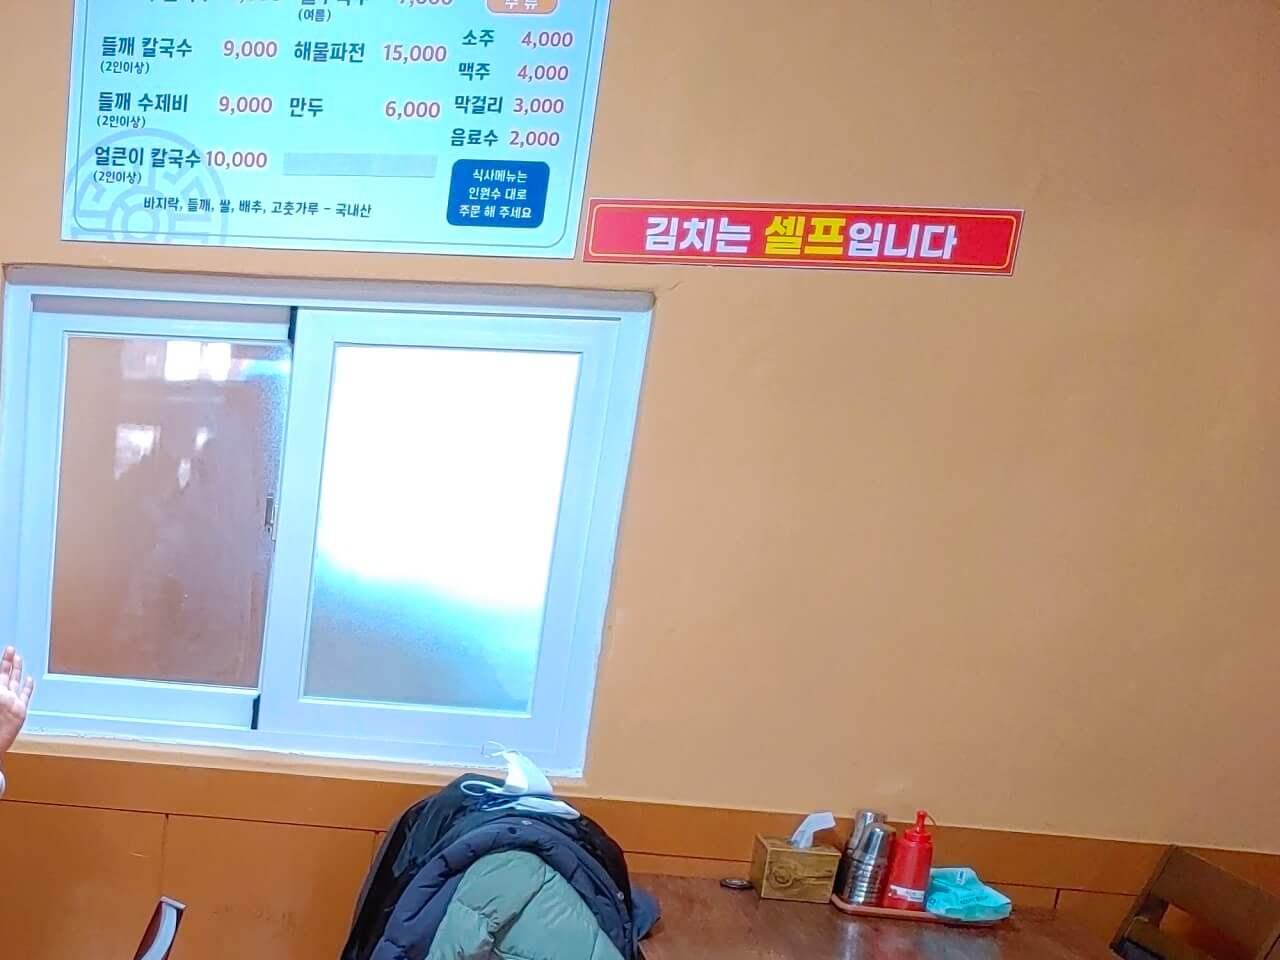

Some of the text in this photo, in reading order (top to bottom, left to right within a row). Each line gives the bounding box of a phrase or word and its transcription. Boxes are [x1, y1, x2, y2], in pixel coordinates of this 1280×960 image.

[298, 8, 331, 22] (여름)
[101, 36, 193, 58] 들깨 칼국수
[462, 30, 495, 48] 소주
[521, 31, 573, 48] 4,000
[223, 39, 278, 59] 9,000
[293, 41, 365, 63] 해물파전
[383, 44, 447, 63] 15,000
[100, 60, 150, 74] (2인이상)
[458, 62, 491, 81] 맥주
[517, 65, 569, 82] 4,000
[98, 92, 188, 112] 들깨 수제비
[218, 96, 273, 115] 9,000
[289, 97, 324, 118] 만두
[385, 101, 441, 119] 6,000
[454, 95, 503, 115] 막걸리
[513, 98, 564, 115] 3,000
[96, 115, 146, 128] (2인이상)
[450, 128, 499, 147] 음료수
[509, 131, 560, 147] 2,000
[95, 146, 201, 168] 얼큰이 칼국수
[206, 150, 268, 169] 10,000
[93, 170, 142, 184] (2인이상)
[472, 168, 528, 183] 식사메뉴는
[469, 186, 527, 201] 인원수 대로
[143, 197, 183, 212] 바지락,
[187, 198, 215, 213] 들깨,
[238, 200, 266, 214] 배추,
[271, 201, 319, 216] 고춧가루
[335, 203, 372, 218] 국내산
[459, 204, 532, 219] 주문 해 주세요
[645, 215, 958, 260] 김치는 셀프입니다
